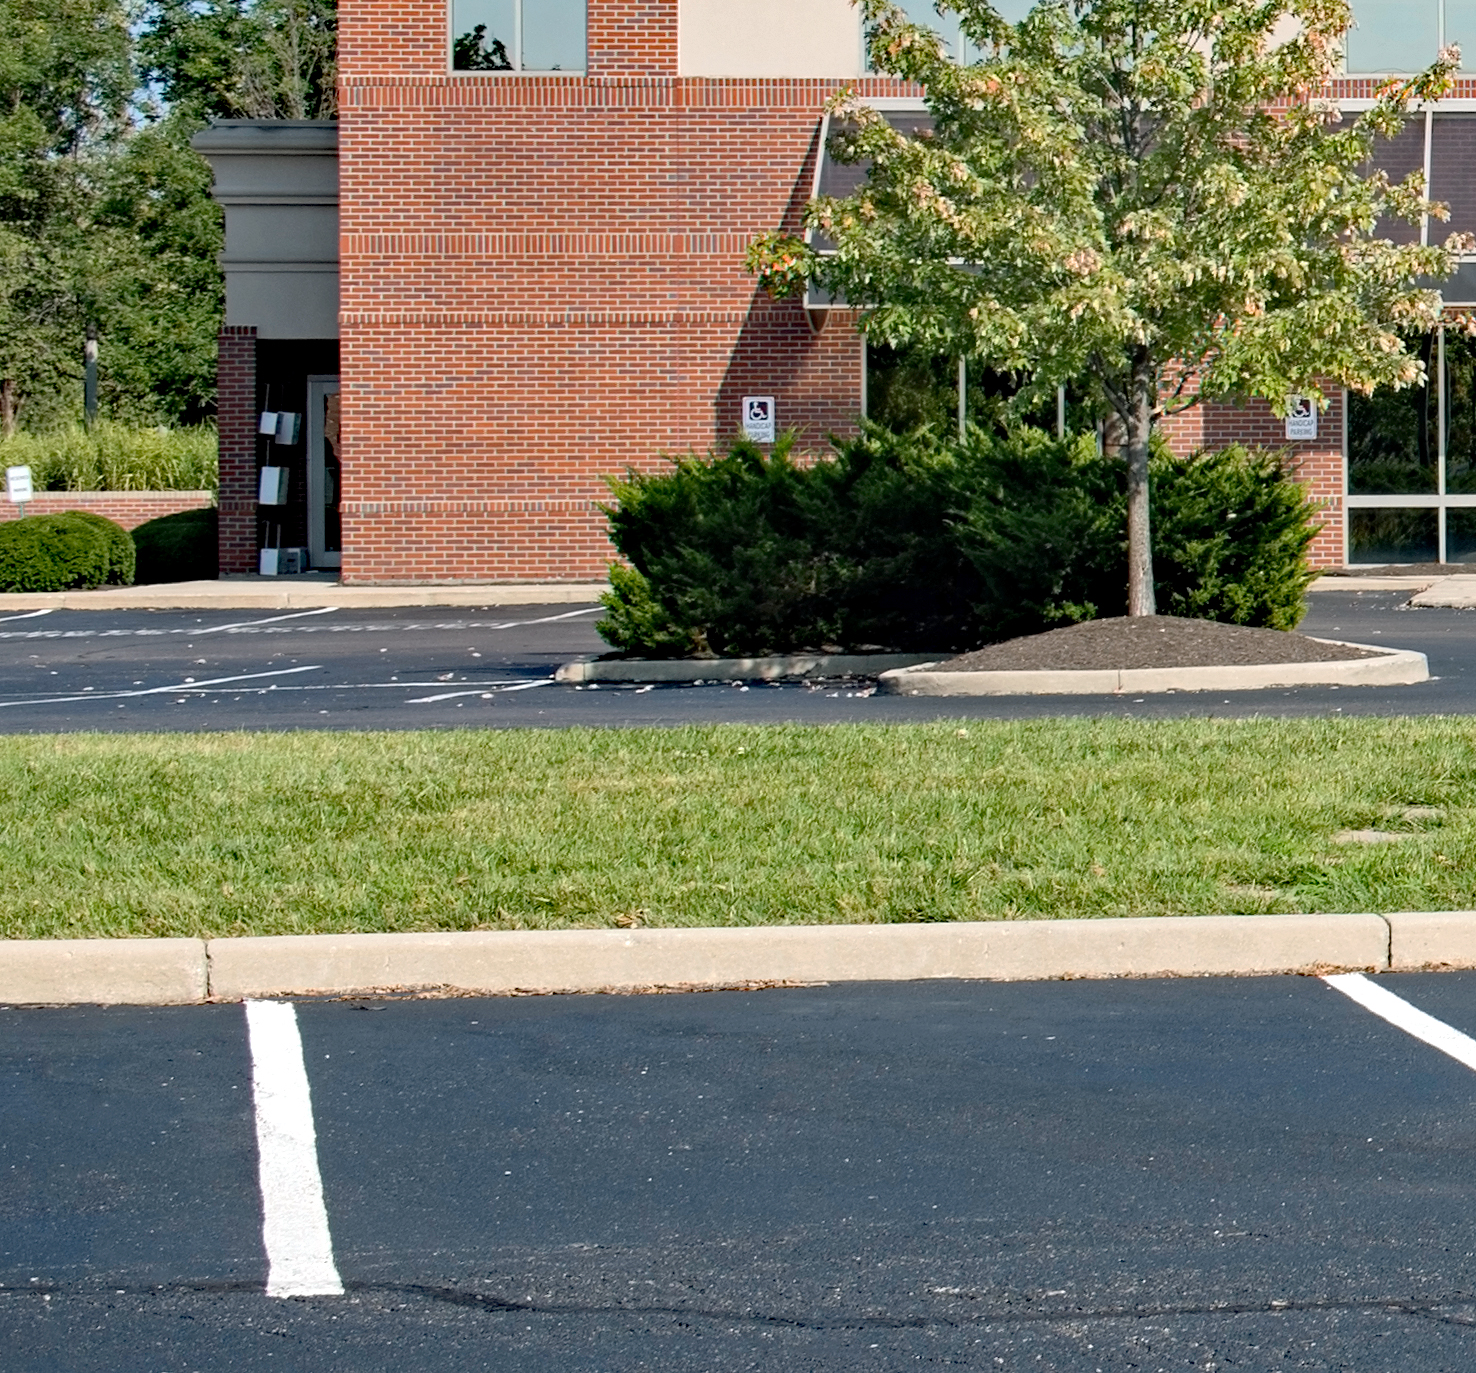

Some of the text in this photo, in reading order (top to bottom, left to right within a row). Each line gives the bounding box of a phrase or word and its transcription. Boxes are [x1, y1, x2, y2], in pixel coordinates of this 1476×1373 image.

[746, 422, 772, 430] HANDICAP
[1288, 419, 1314, 428] HANDICAP
[1290, 428, 1313, 436] PARKING
